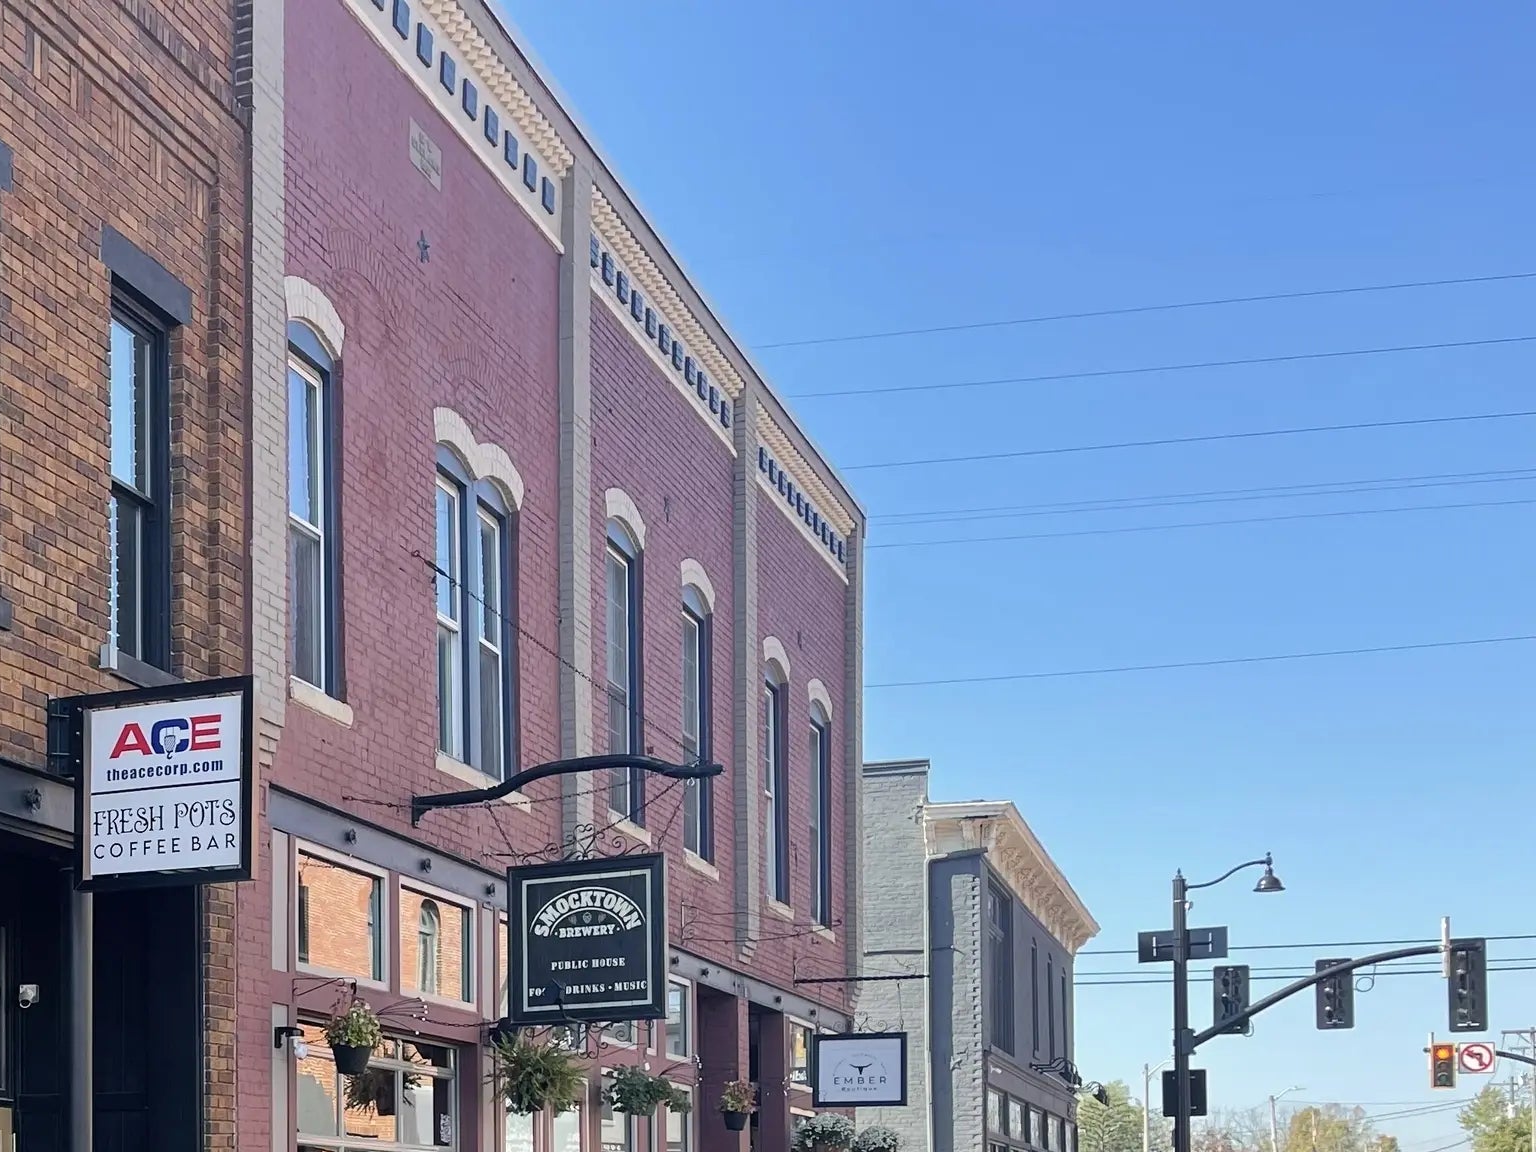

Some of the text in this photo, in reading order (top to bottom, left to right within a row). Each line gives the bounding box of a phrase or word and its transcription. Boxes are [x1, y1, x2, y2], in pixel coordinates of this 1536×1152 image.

[109, 714, 222, 760] ACE
[107, 760, 224, 782] theacecorp.com
[94, 799, 236, 836] FRESH POTS
[94, 833, 236, 859] COFFEE BAR
[534, 891, 642, 937] SMOCKTOWN
[559, 925, 615, 938] BREWERY
[551, 957, 626, 970] PUBLIC HOUSE
[565, 984, 605, 994] DRINKS
[614, 980, 648, 991] MUSIC
[833, 1076, 887, 1085] EMBER
